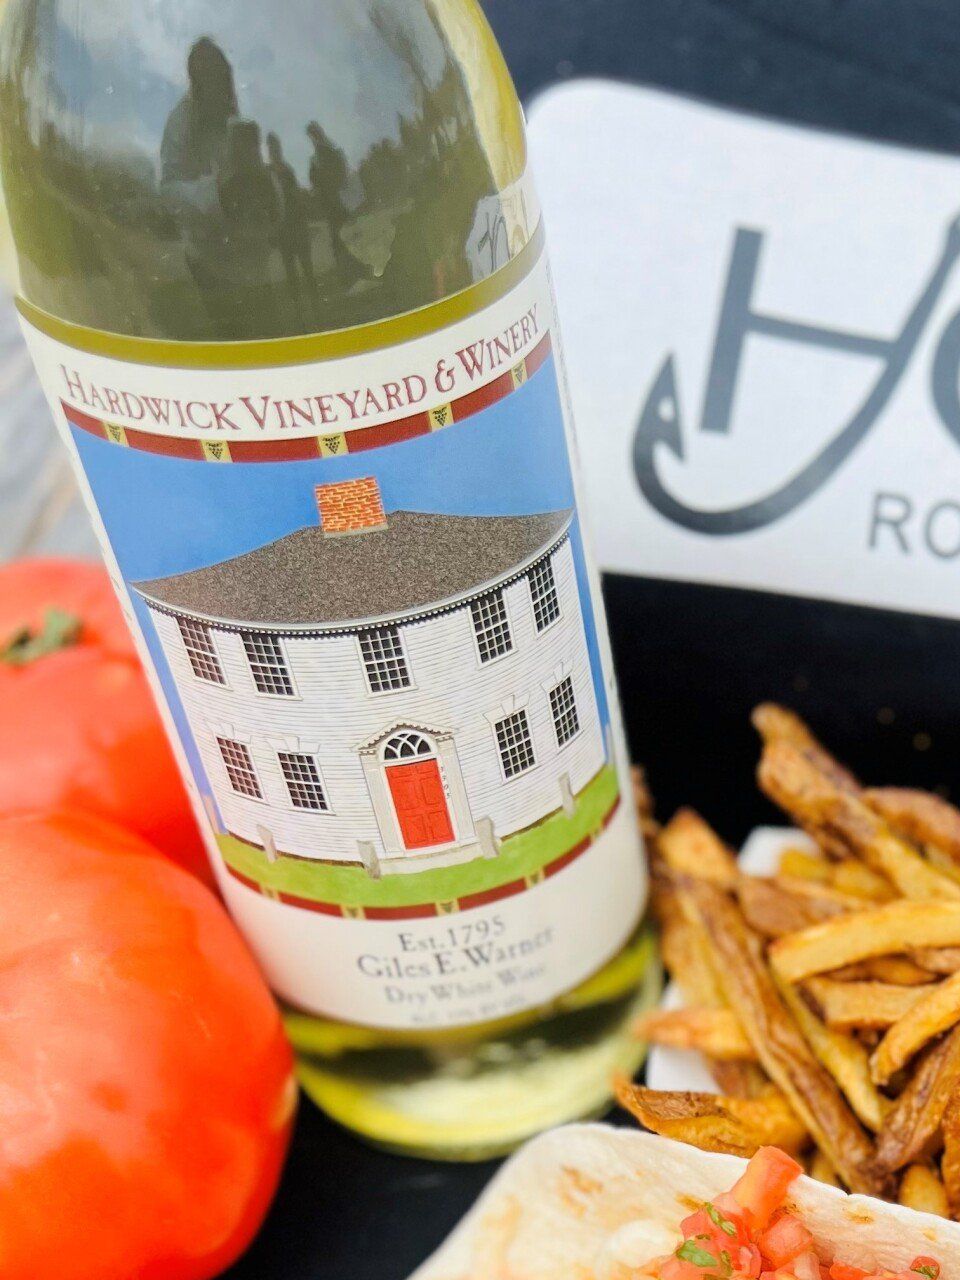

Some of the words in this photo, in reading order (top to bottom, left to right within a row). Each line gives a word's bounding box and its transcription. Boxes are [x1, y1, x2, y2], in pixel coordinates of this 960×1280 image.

[59, 363, 240, 431] HARDWICK
[242, 375, 427, 430] VINEYARD
[434, 360, 455, 393] &
[454, 303, 539, 375] WINERY
[357, 954, 431, 979] Giles
